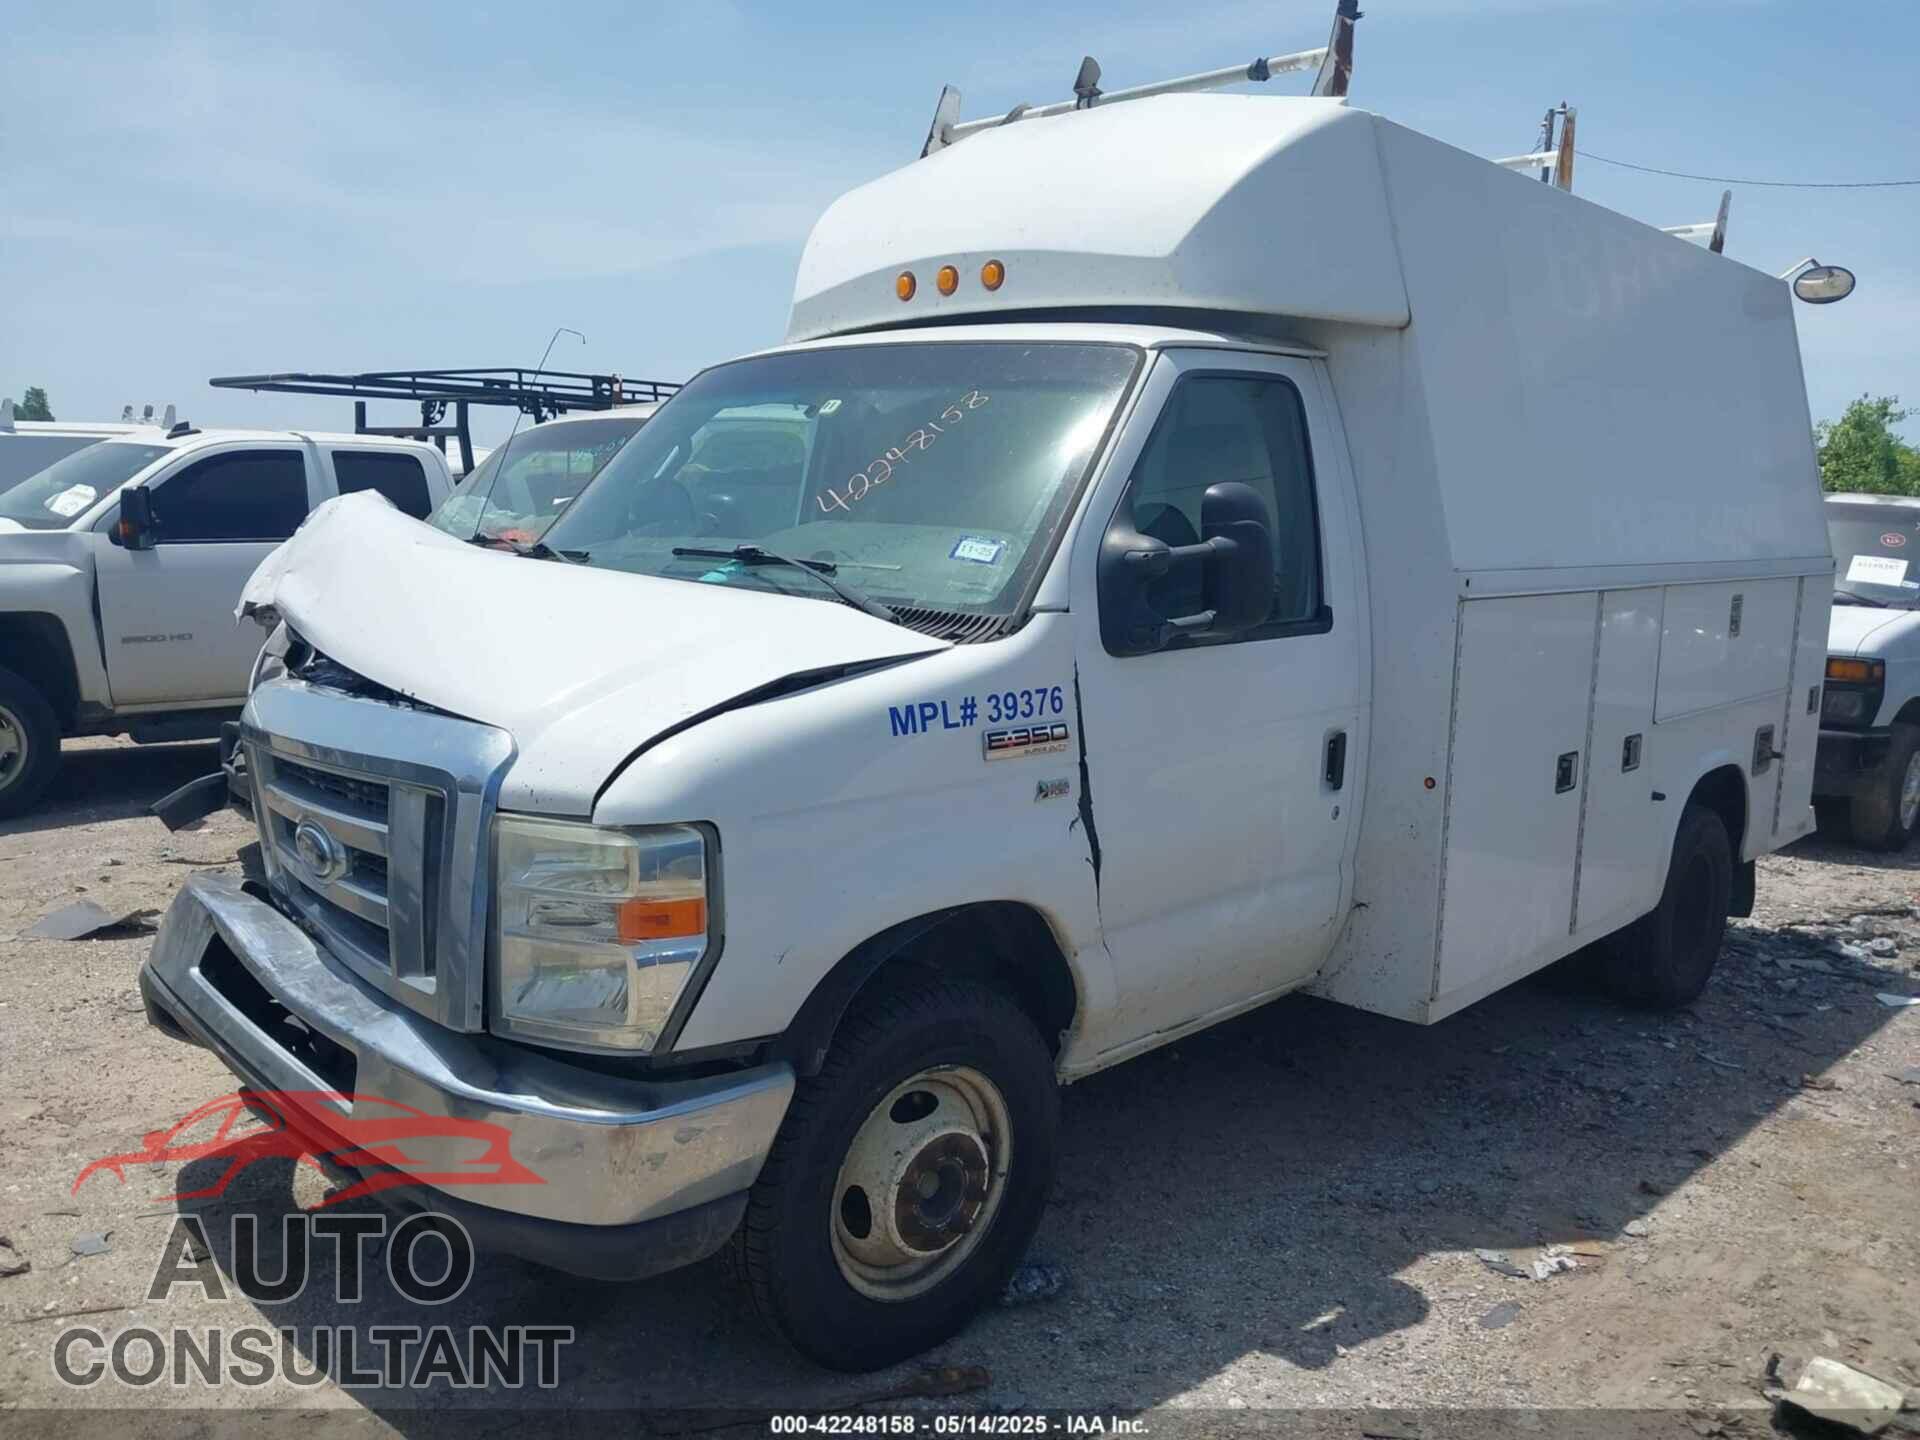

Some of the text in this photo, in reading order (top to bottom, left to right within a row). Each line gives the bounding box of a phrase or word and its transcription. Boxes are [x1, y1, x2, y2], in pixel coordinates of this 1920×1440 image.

[816, 390, 989, 512] 42248158
[121, 634, 168, 644] 00
[889, 686, 1064, 736] MPL# 39376
